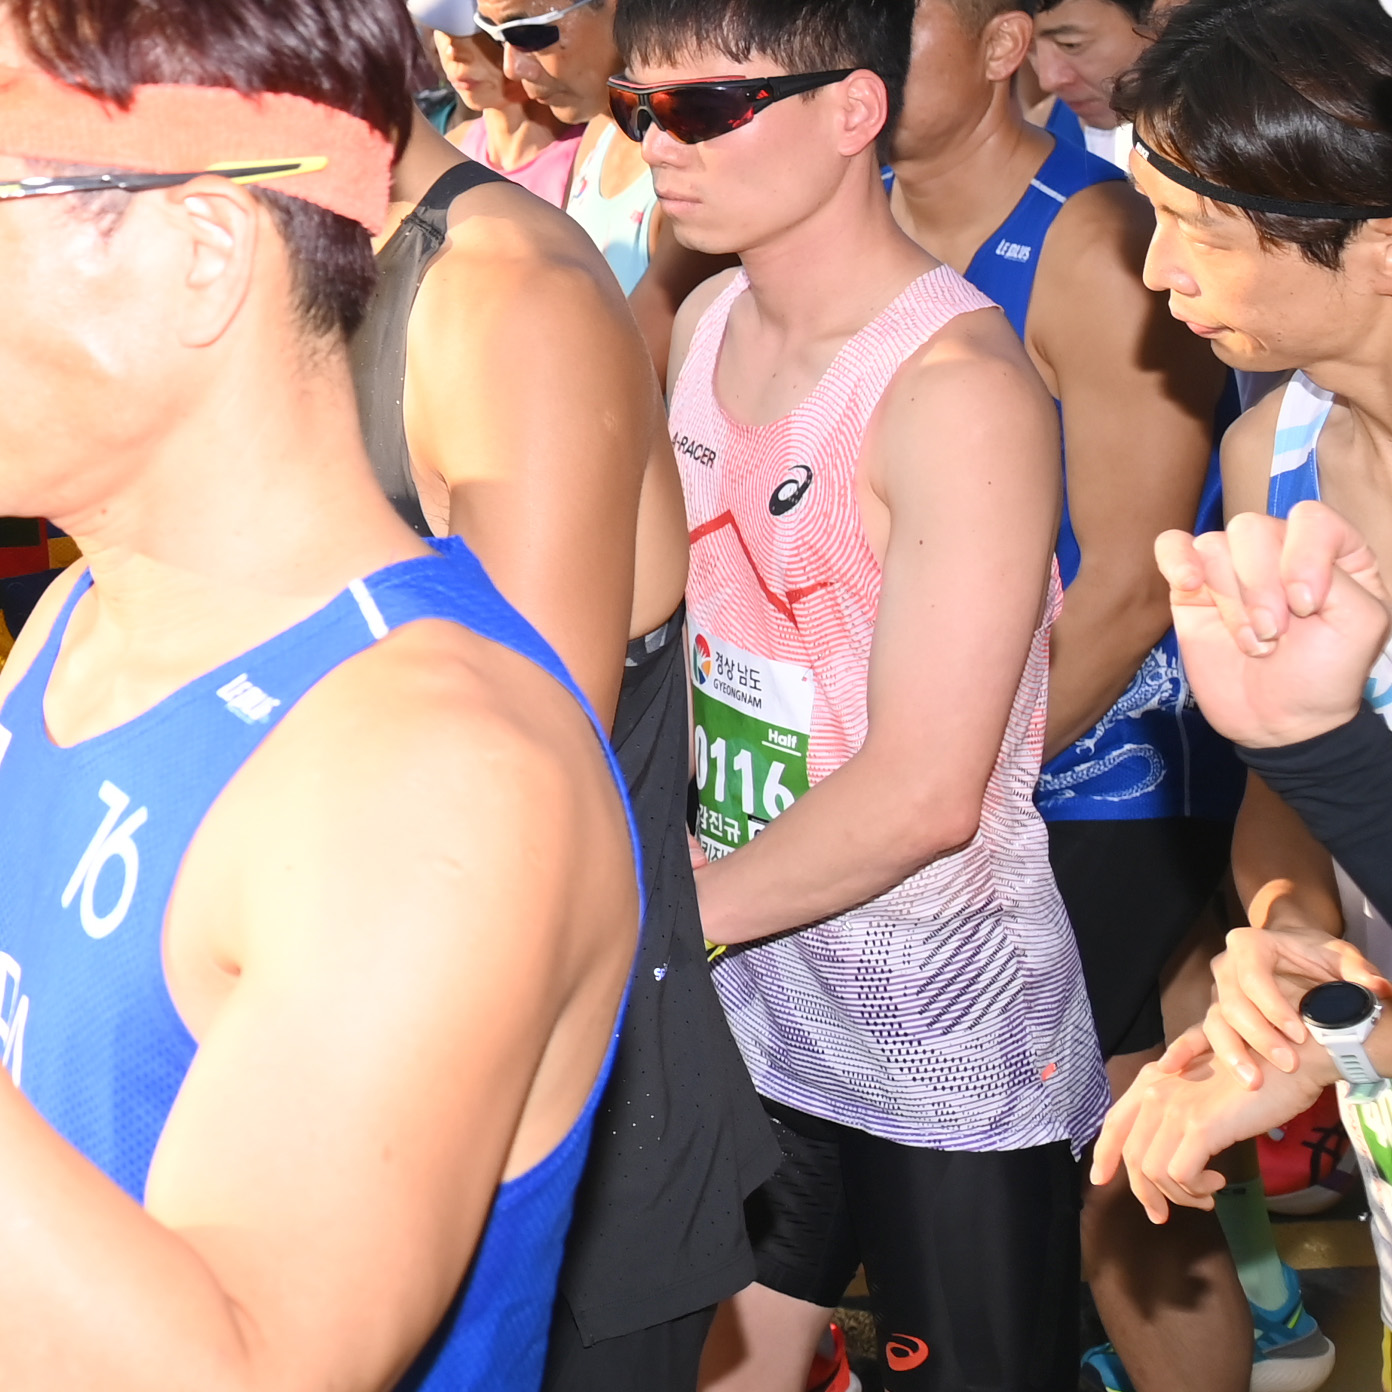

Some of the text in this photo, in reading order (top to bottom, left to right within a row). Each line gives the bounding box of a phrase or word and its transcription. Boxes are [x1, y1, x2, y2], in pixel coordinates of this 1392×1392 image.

[715, 651, 763, 692] 경상남도
[713, 677, 762, 710] GYEONGNAM
[768, 728, 798, 749] Half
